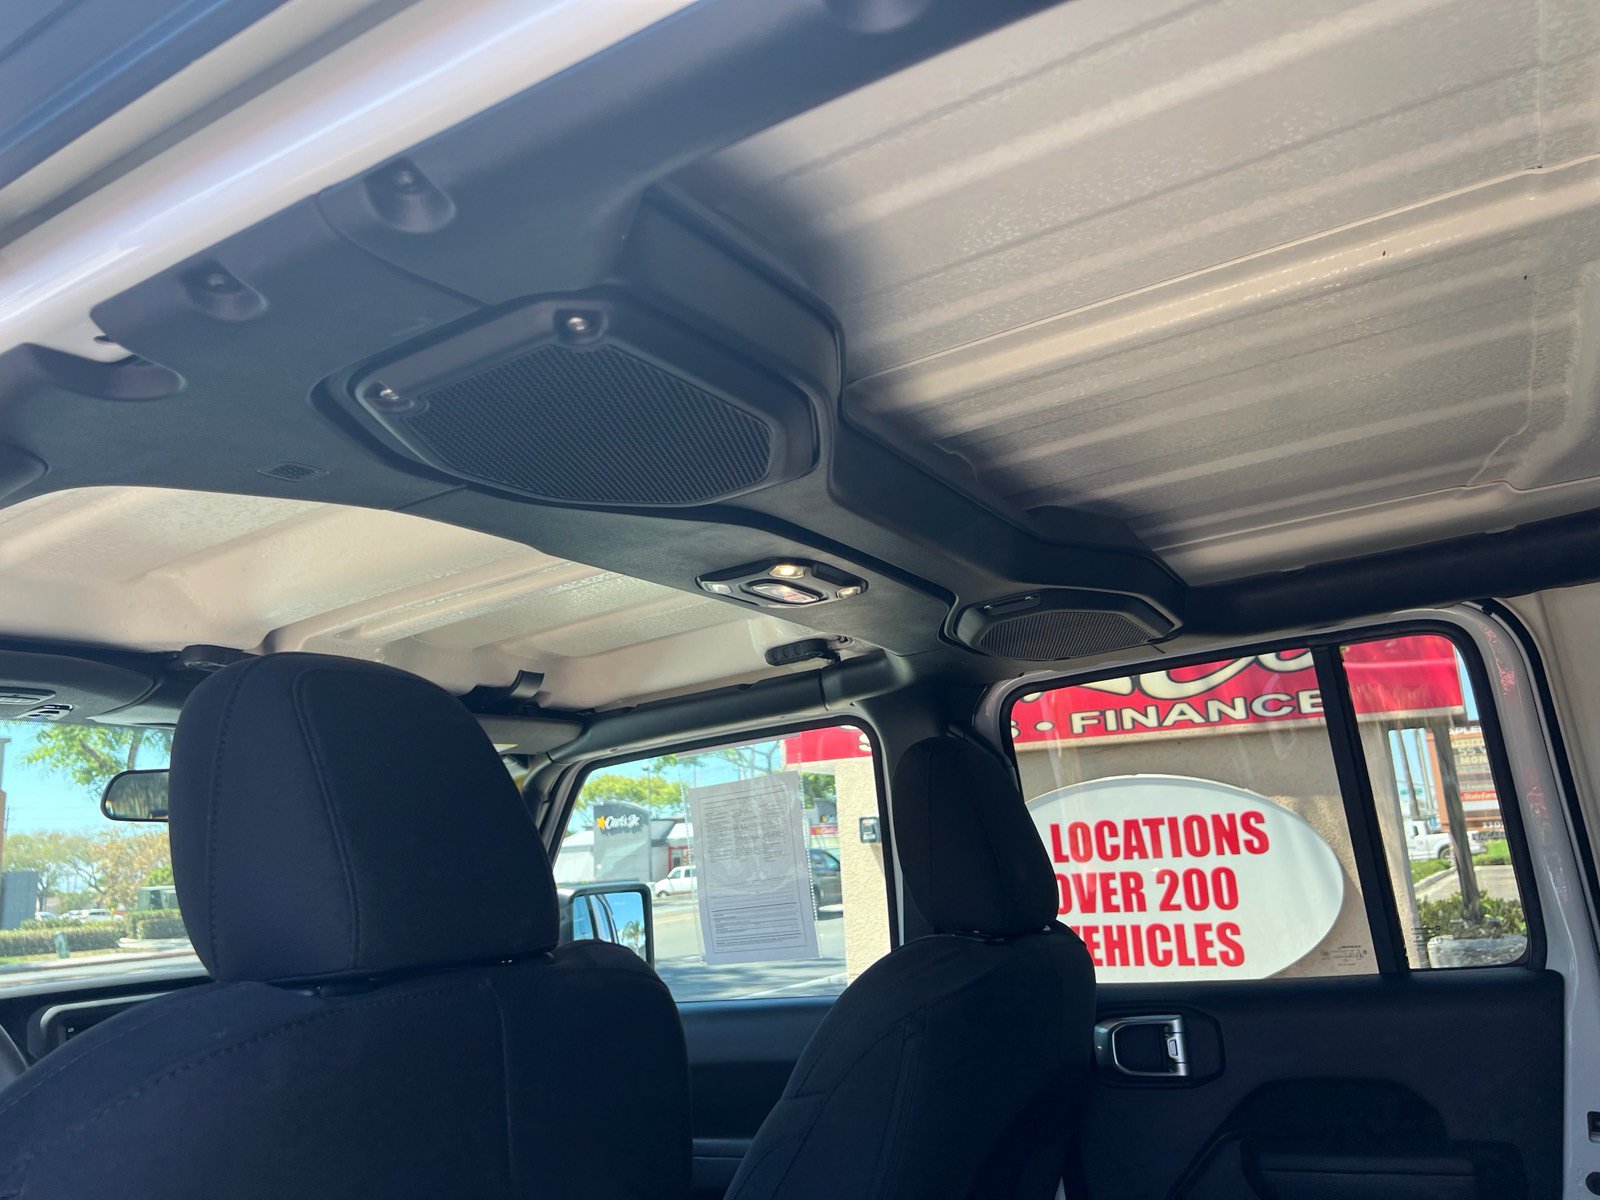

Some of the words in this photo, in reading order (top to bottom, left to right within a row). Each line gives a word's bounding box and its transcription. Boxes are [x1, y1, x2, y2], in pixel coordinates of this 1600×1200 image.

[1071, 688, 1324, 734] FINANCE
[1049, 811, 1270, 863] LOCATIONS
[1055, 871, 1147, 915] OVER
[1155, 866, 1239, 912] 200
[1071, 922, 1245, 968] EHICLES
